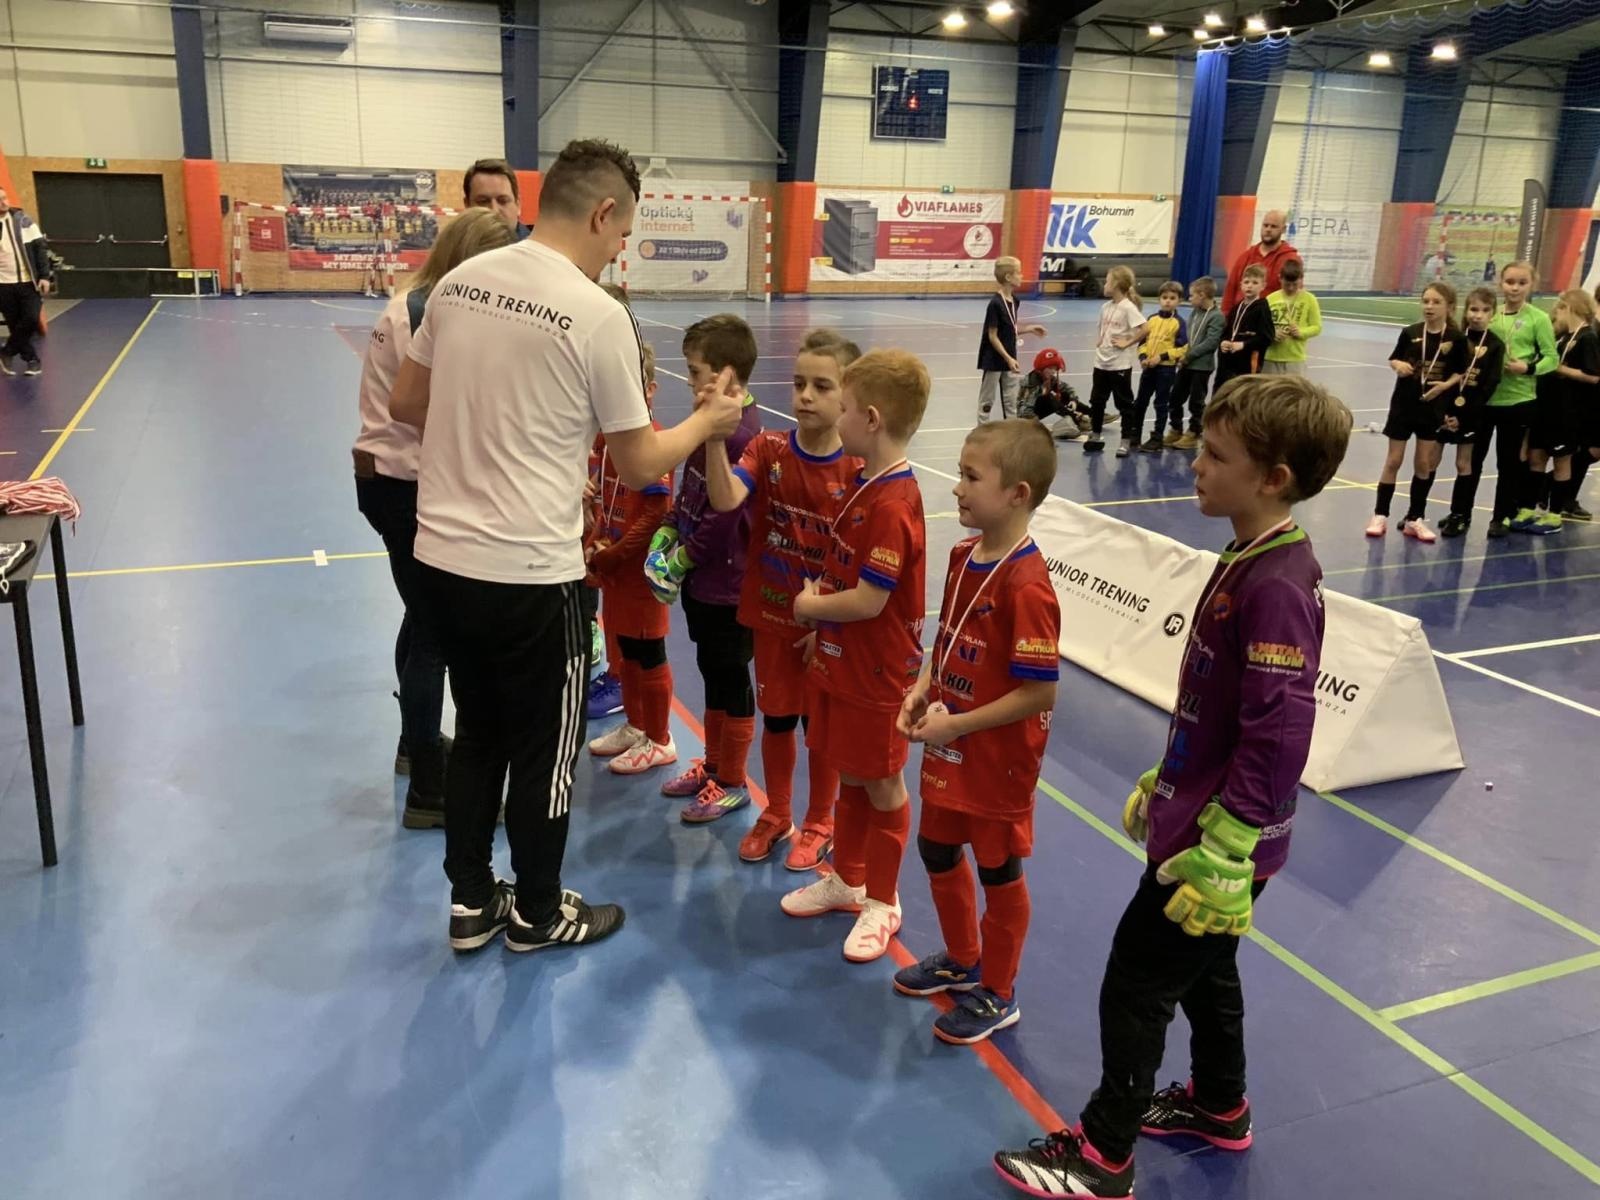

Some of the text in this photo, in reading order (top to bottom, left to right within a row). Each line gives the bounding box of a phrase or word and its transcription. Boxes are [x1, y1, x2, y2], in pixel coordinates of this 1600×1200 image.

[914, 200, 983, 214] VIAFLAMES
[640, 219, 695, 232] internet
[440, 283, 573, 331] JUNIOR TRENING
[1090, 576, 1150, 613] TRENING
